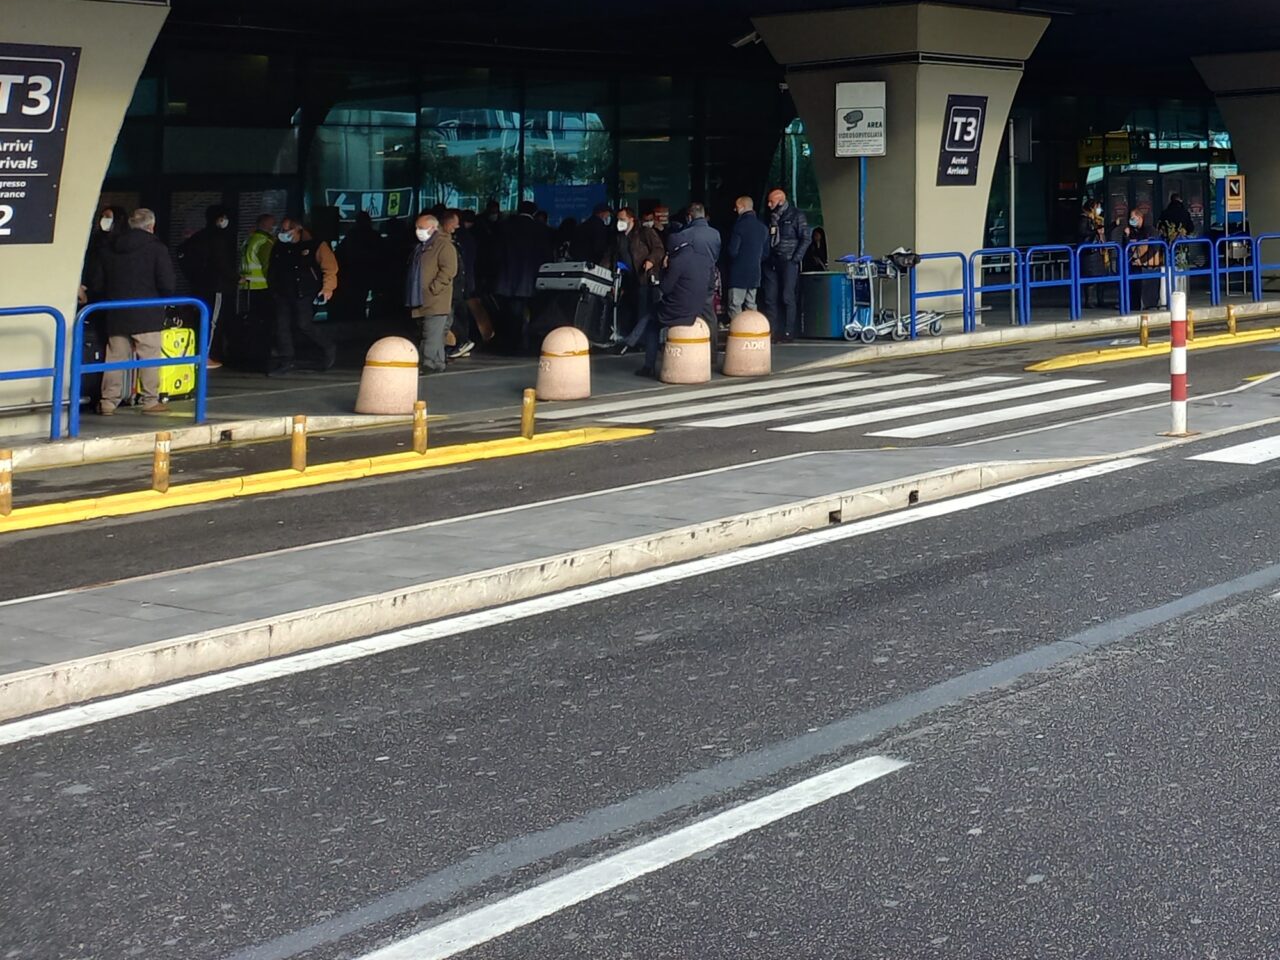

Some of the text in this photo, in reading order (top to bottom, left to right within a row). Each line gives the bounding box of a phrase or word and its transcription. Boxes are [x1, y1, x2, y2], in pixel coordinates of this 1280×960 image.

[0, 74, 53, 117] T3
[867, 121, 883, 129] AREA
[953, 116, 977, 141] T3
[0, 191, 26, 199] rance
